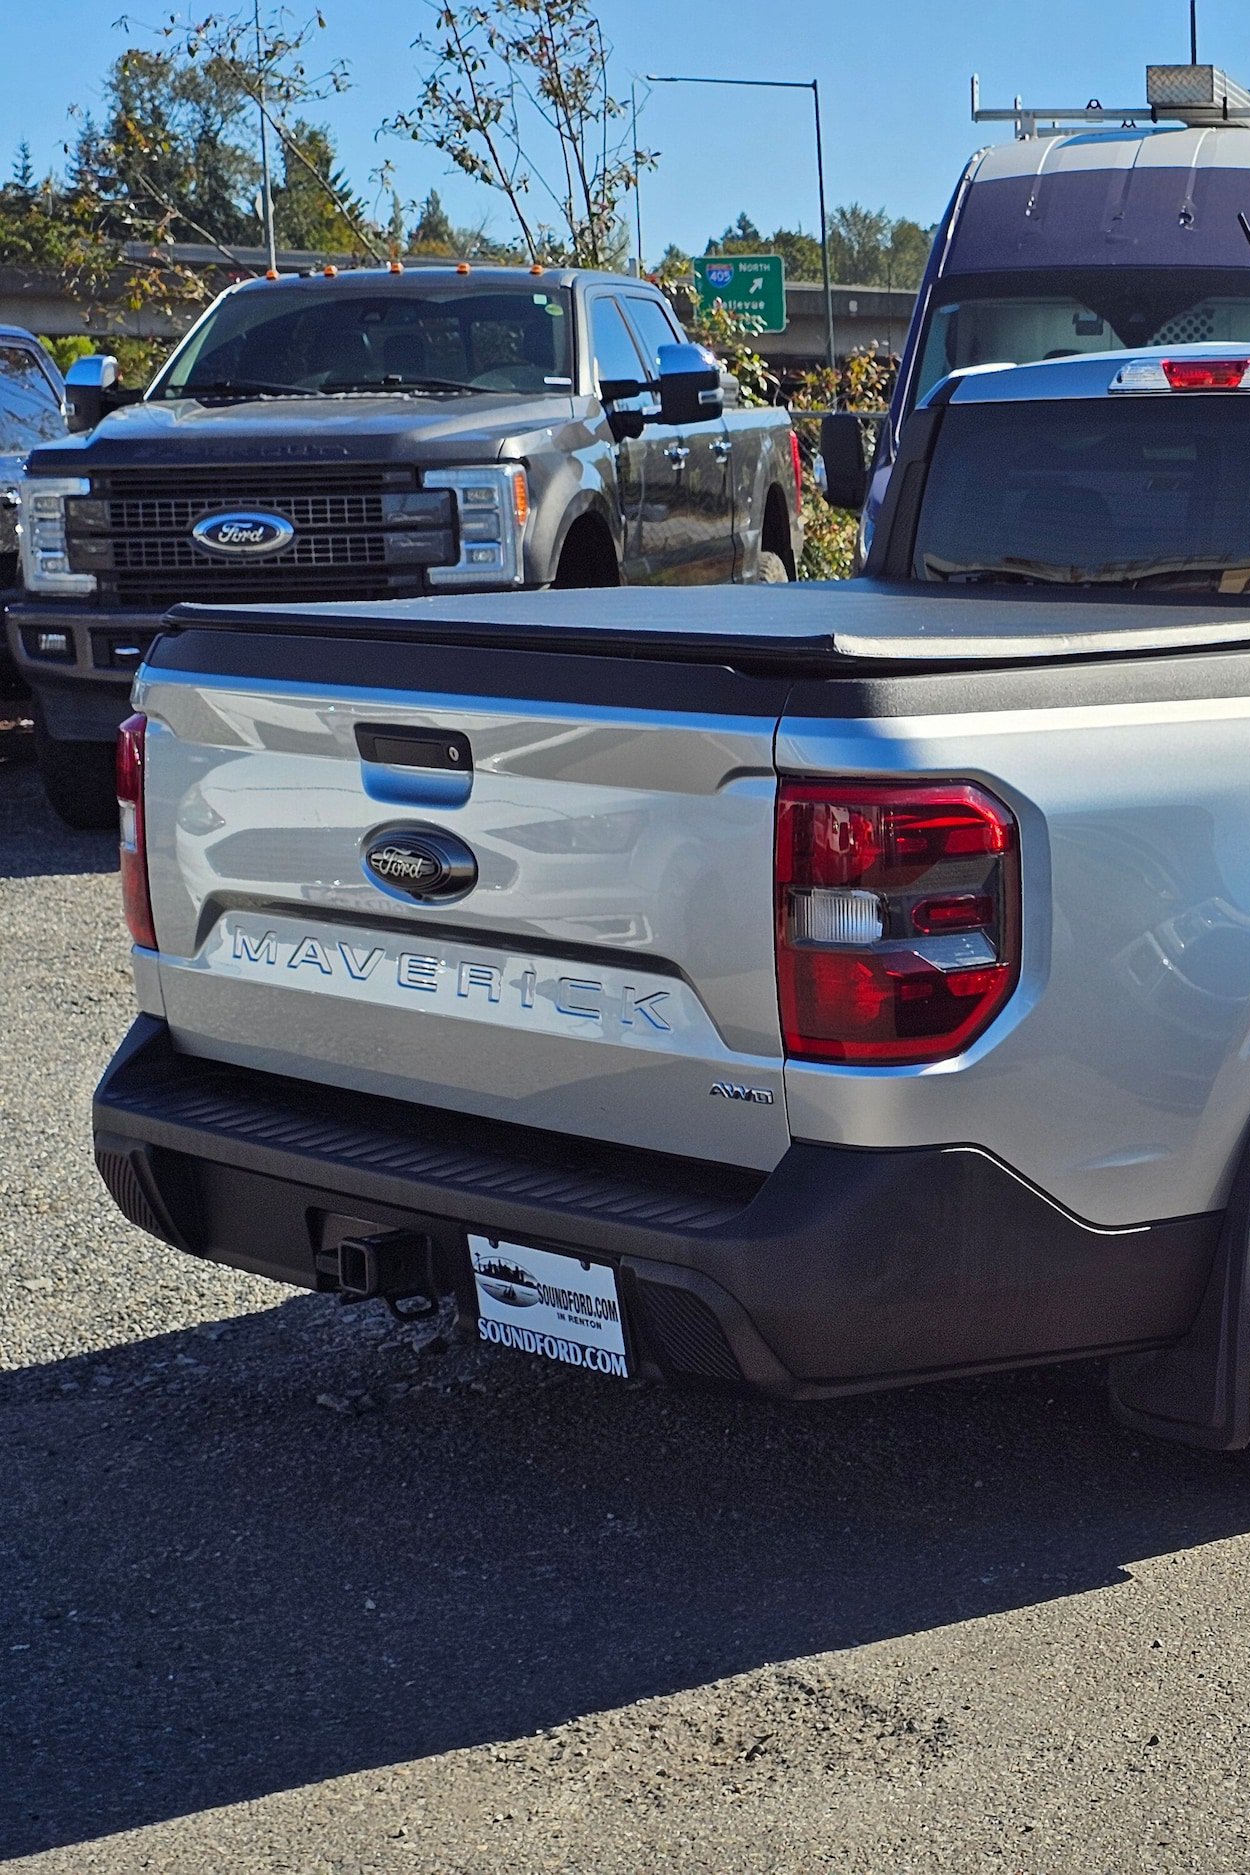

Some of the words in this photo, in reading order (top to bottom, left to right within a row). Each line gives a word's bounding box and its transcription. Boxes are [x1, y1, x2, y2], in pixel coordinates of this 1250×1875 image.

[710, 271, 731, 282] 405
[738, 262, 771, 272] NORTH
[218, 522, 265, 543] Ford
[379, 846, 423, 879] Ford
[232, 925, 671, 1032] MAVERICK
[709, 1081, 774, 1105] AWD
[537, 1283, 619, 1323] SOUNDFORD.COM
[557, 1311, 566, 1321] IN
[568, 1314, 602, 1330] RENTON
[478, 1318, 629, 1378] SOUNDFORD.COM
